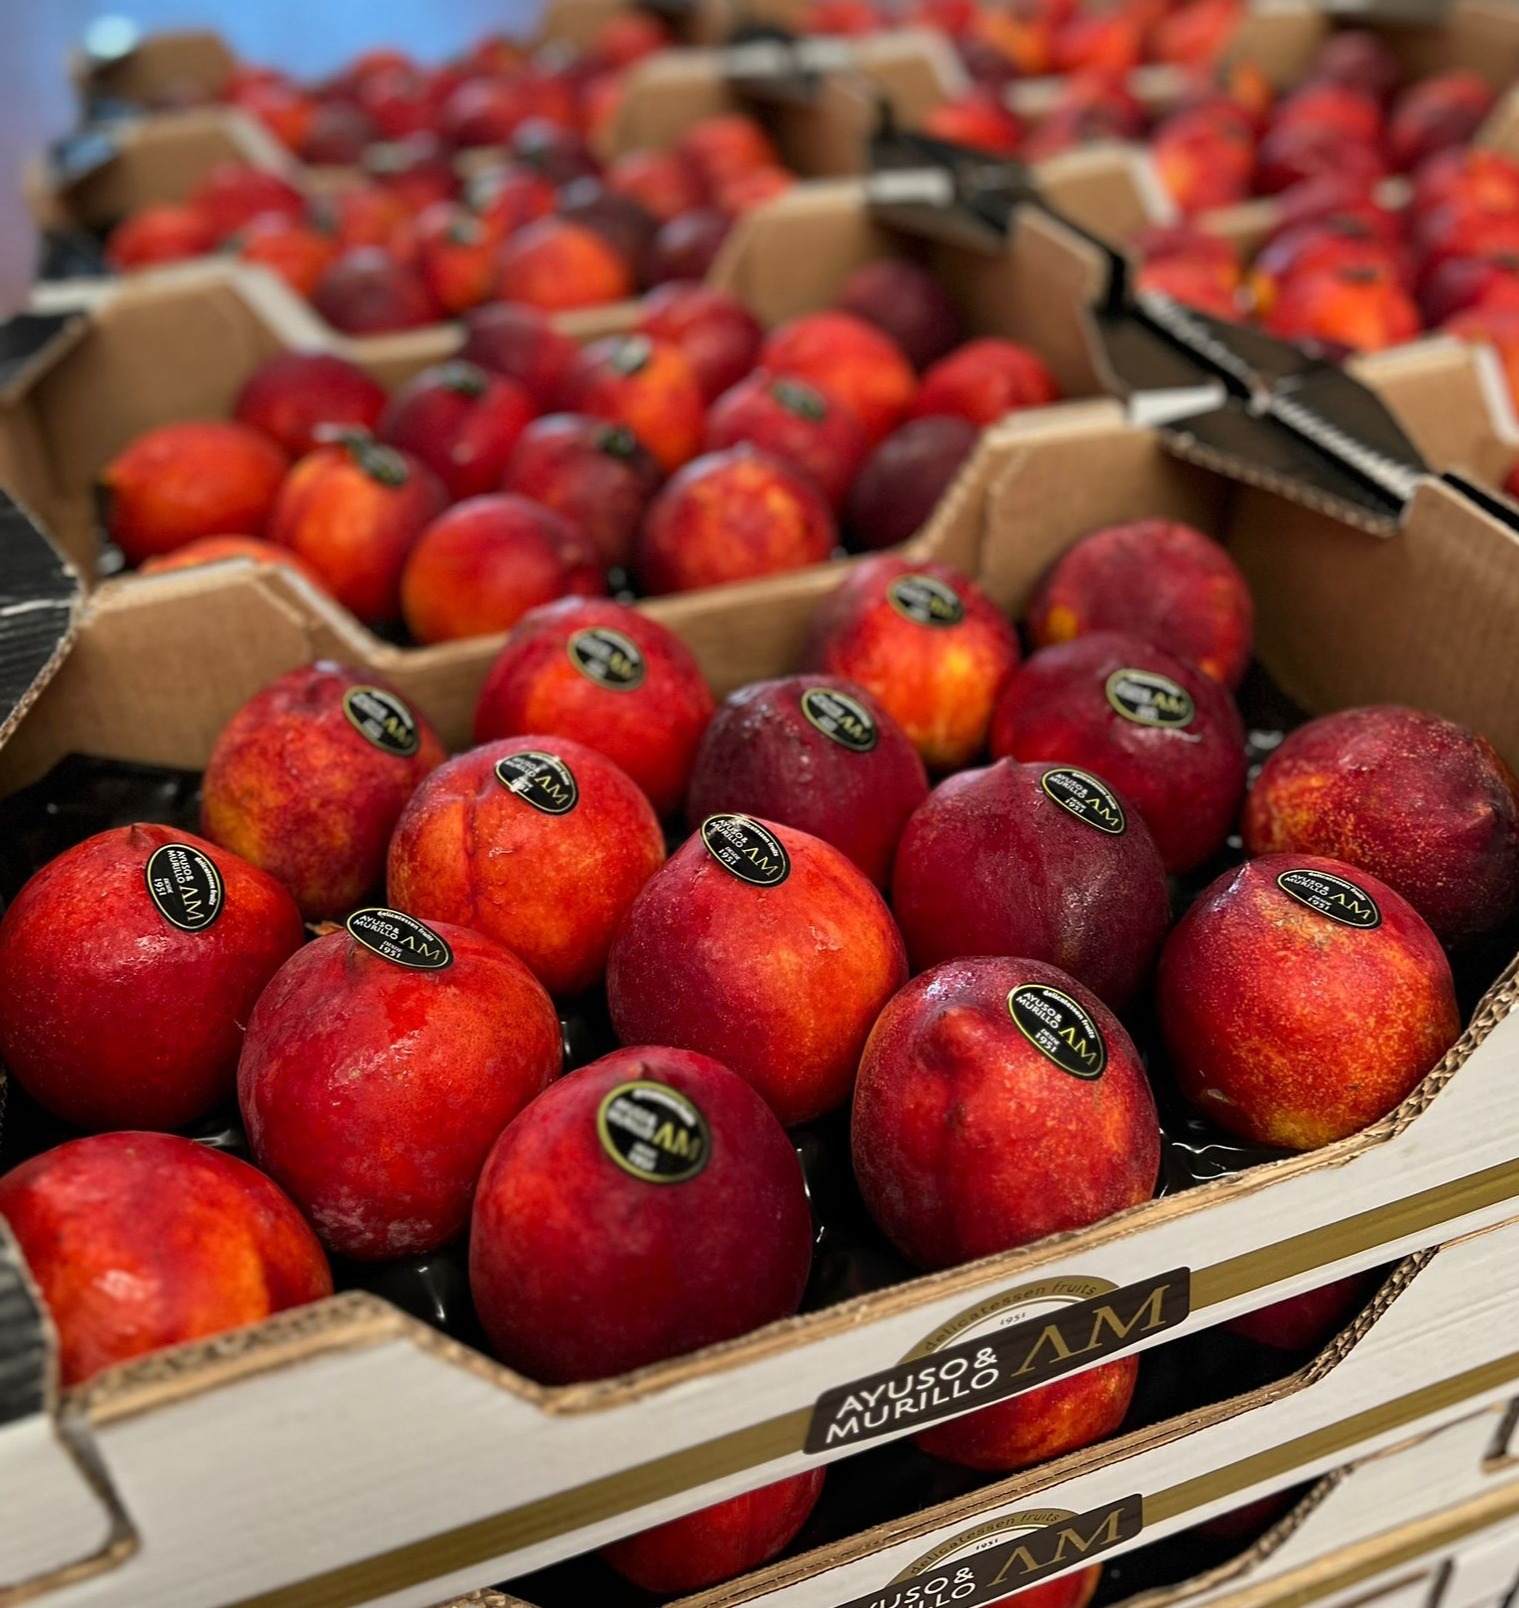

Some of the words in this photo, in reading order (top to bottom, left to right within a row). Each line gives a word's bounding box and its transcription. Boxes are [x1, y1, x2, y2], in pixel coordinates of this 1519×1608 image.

[534, 775, 569, 805] AM
[1047, 776, 1086, 799] MURILLO
[1055, 773, 1089, 796] AYUSO&
[1064, 798, 1085, 813] 1951
[1085, 798, 1119, 827] AM
[709, 821, 744, 848] MURILLO
[717, 819, 749, 844] AYUSO&
[167, 850, 186, 884] MURILLO
[176, 850, 195, 882] AYUSO&
[718, 848, 738, 865] 1951
[741, 847, 779, 877] AM
[154, 878, 168, 896] 1951
[1283, 877, 1328, 896] MURILLO
[1290, 874, 1331, 892] AYUSO&
[179, 885, 205, 922] AM
[1307, 897, 1331, 911] 1951
[1328, 893, 1372, 921] AM
[353, 919, 398, 940] MURILLO
[359, 915, 400, 934] AYUSO&
[378, 944, 402, 959] 1951
[383, 940, 403, 953] DESDE
[399, 935, 441, 960] AM
[1015, 996, 1059, 1029] MURILLO
[1022, 992, 1063, 1023] AYUSO&
[1040, 1028, 1061, 1046] DESDE
[1081, 1018, 1096, 1039] fruits
[1034, 1032, 1058, 1053] 1951
[1058, 1027, 1097, 1066] AM
[925, 1284, 1047, 1353] delicatessen
[1052, 1280, 1098, 1299] fruits
[999, 1311, 1027, 1326] 1951
[1011, 1284, 1171, 1377] AM
[835, 1346, 999, 1419] AYUSO&
[825, 1368, 999, 1443] MURILLO
[911, 1516, 1016, 1574] delicatessen
[1020, 1511, 1061, 1525] fruits
[975, 1538, 999, 1551] 1951
[986, 1507, 1125, 1587] AM
